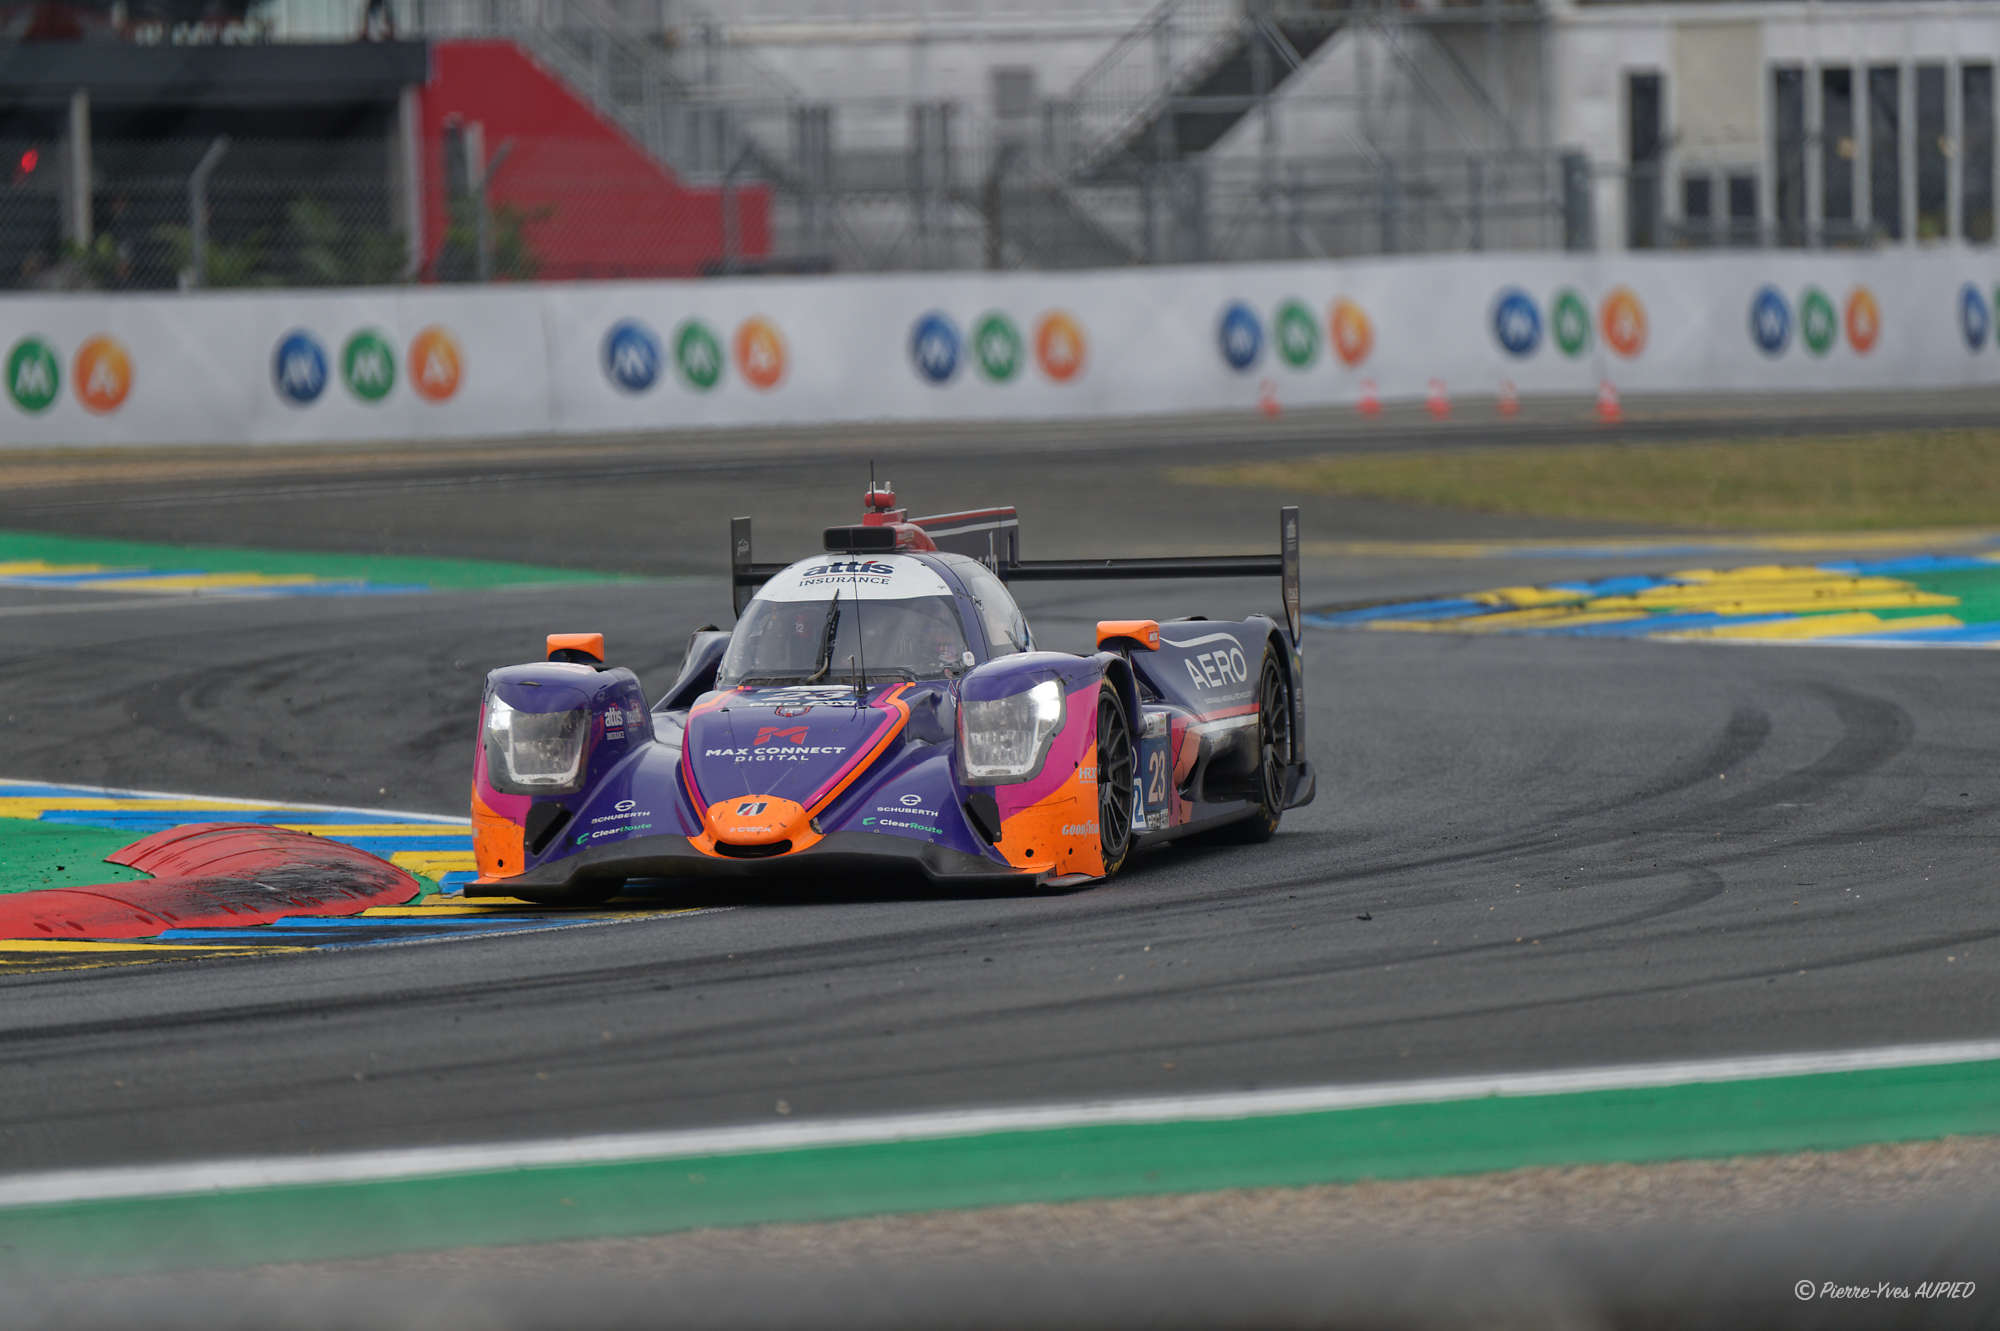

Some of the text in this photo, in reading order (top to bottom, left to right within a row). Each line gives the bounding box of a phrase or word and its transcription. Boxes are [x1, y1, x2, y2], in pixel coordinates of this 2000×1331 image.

[803, 560, 895, 577] attis
[799, 576, 890, 587] INSURANCE
[1184, 647, 1247, 690] AERO
[705, 746, 846, 757] MAX CONNECT
[1148, 750, 1166, 803] 23
[591, 811, 651, 824] SCHUBERTH
[877, 806, 939, 817] SCHUBERTH
[880, 819, 943, 835] ClearRoute
